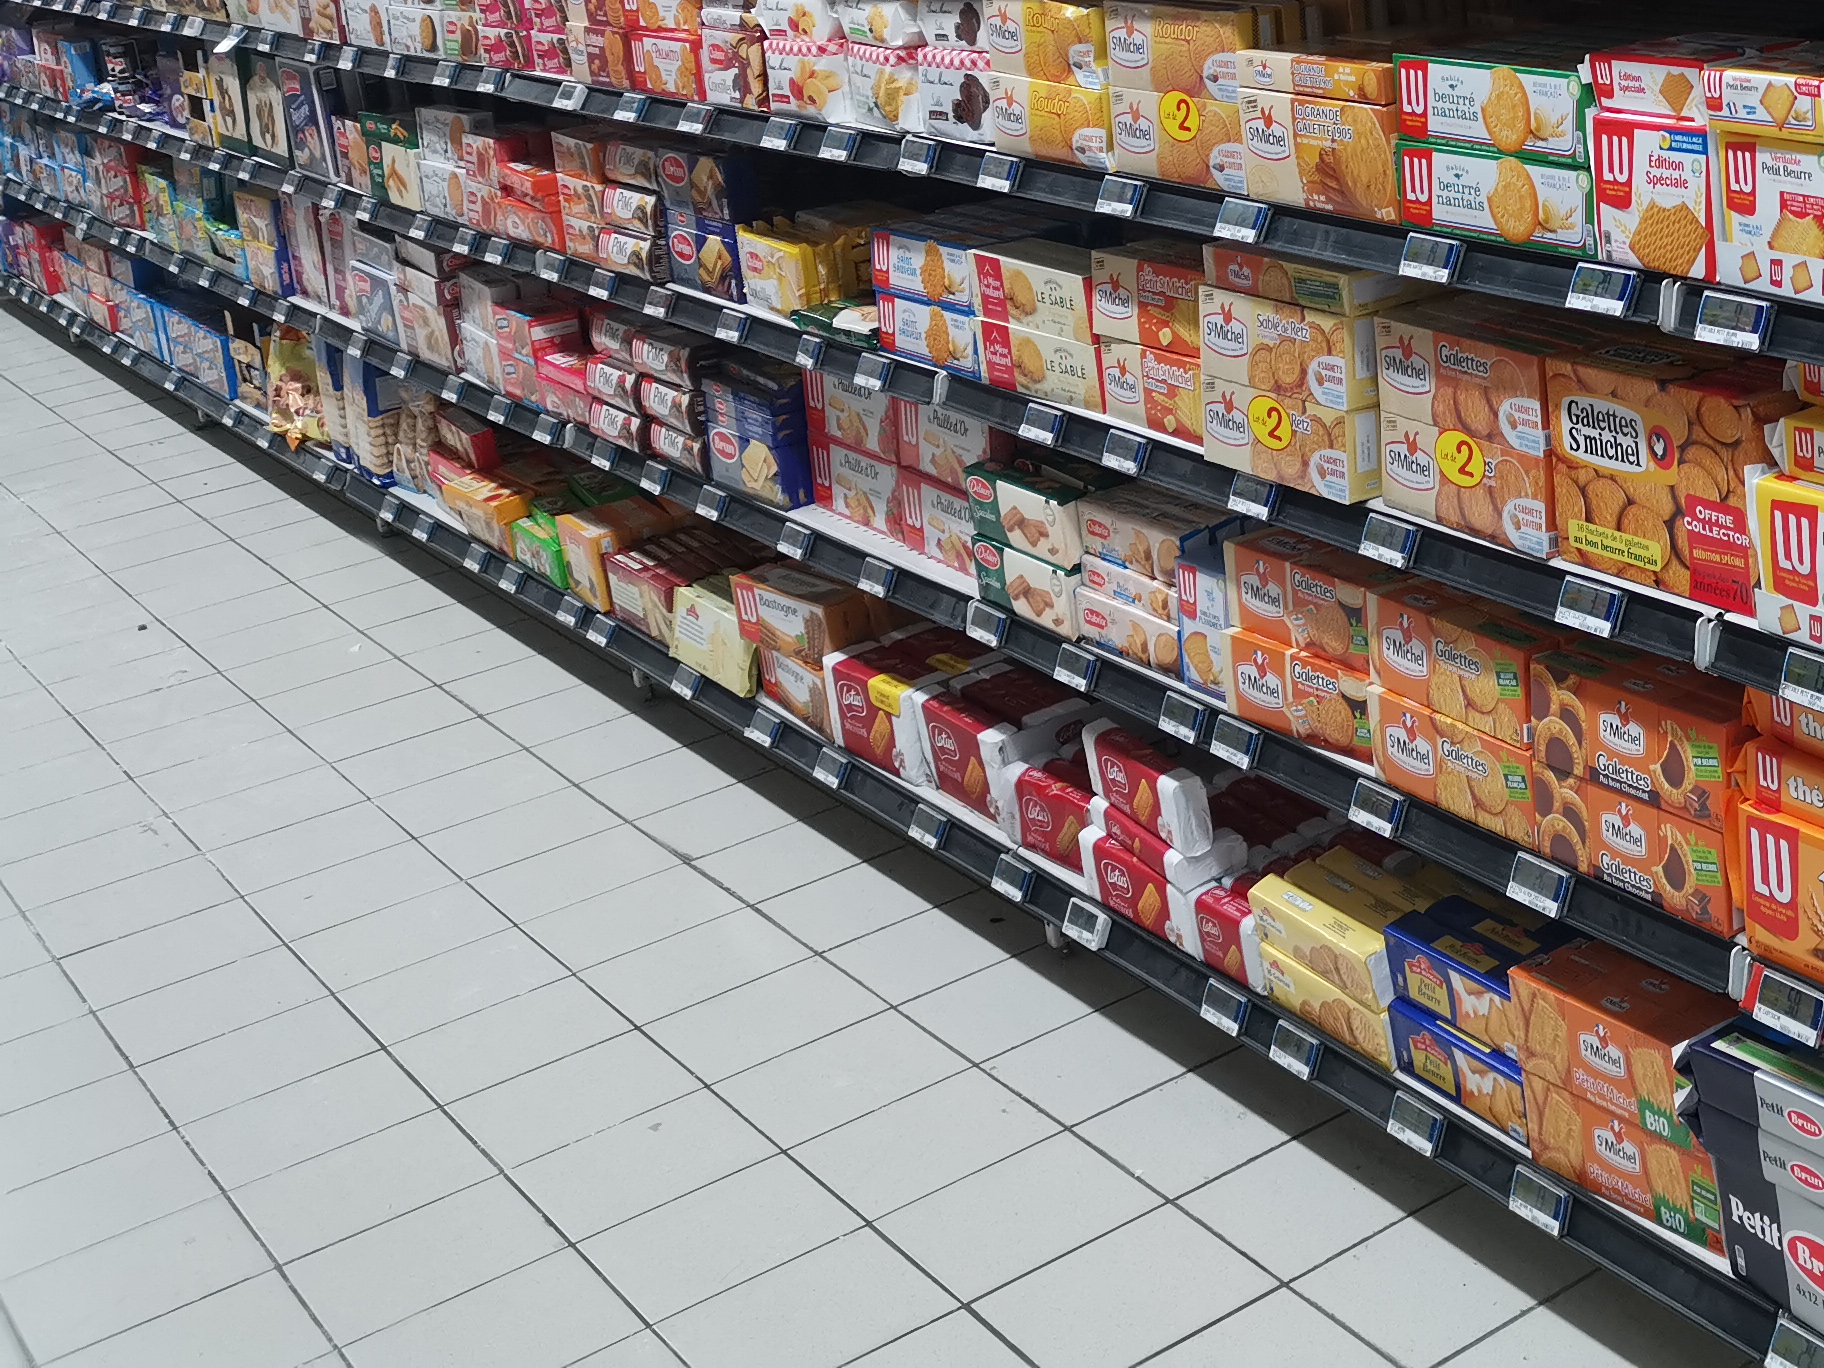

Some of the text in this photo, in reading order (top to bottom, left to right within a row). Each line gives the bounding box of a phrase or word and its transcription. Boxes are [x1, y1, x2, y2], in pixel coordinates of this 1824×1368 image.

[1154, 18, 1198, 42] Roudor
[1433, 92, 1475, 108] beurré
[1431, 105, 1479, 123] nantais
[1648, 153, 1685, 172] Édition
[1646, 171, 1689, 190] Spéciale
[1567, 397, 1637, 438] Galettes
[1696, 507, 1734, 527] OFFRE
[1684, 520, 1750, 547] COLLECTOR
[759, 592, 798, 615] Bastogne
[1292, 663, 1338, 693] Galettes
[1596, 754, 1649, 789] Galettes
[1750, 828, 1791, 902] LU
[1730, 1195, 1781, 1248] Petit
